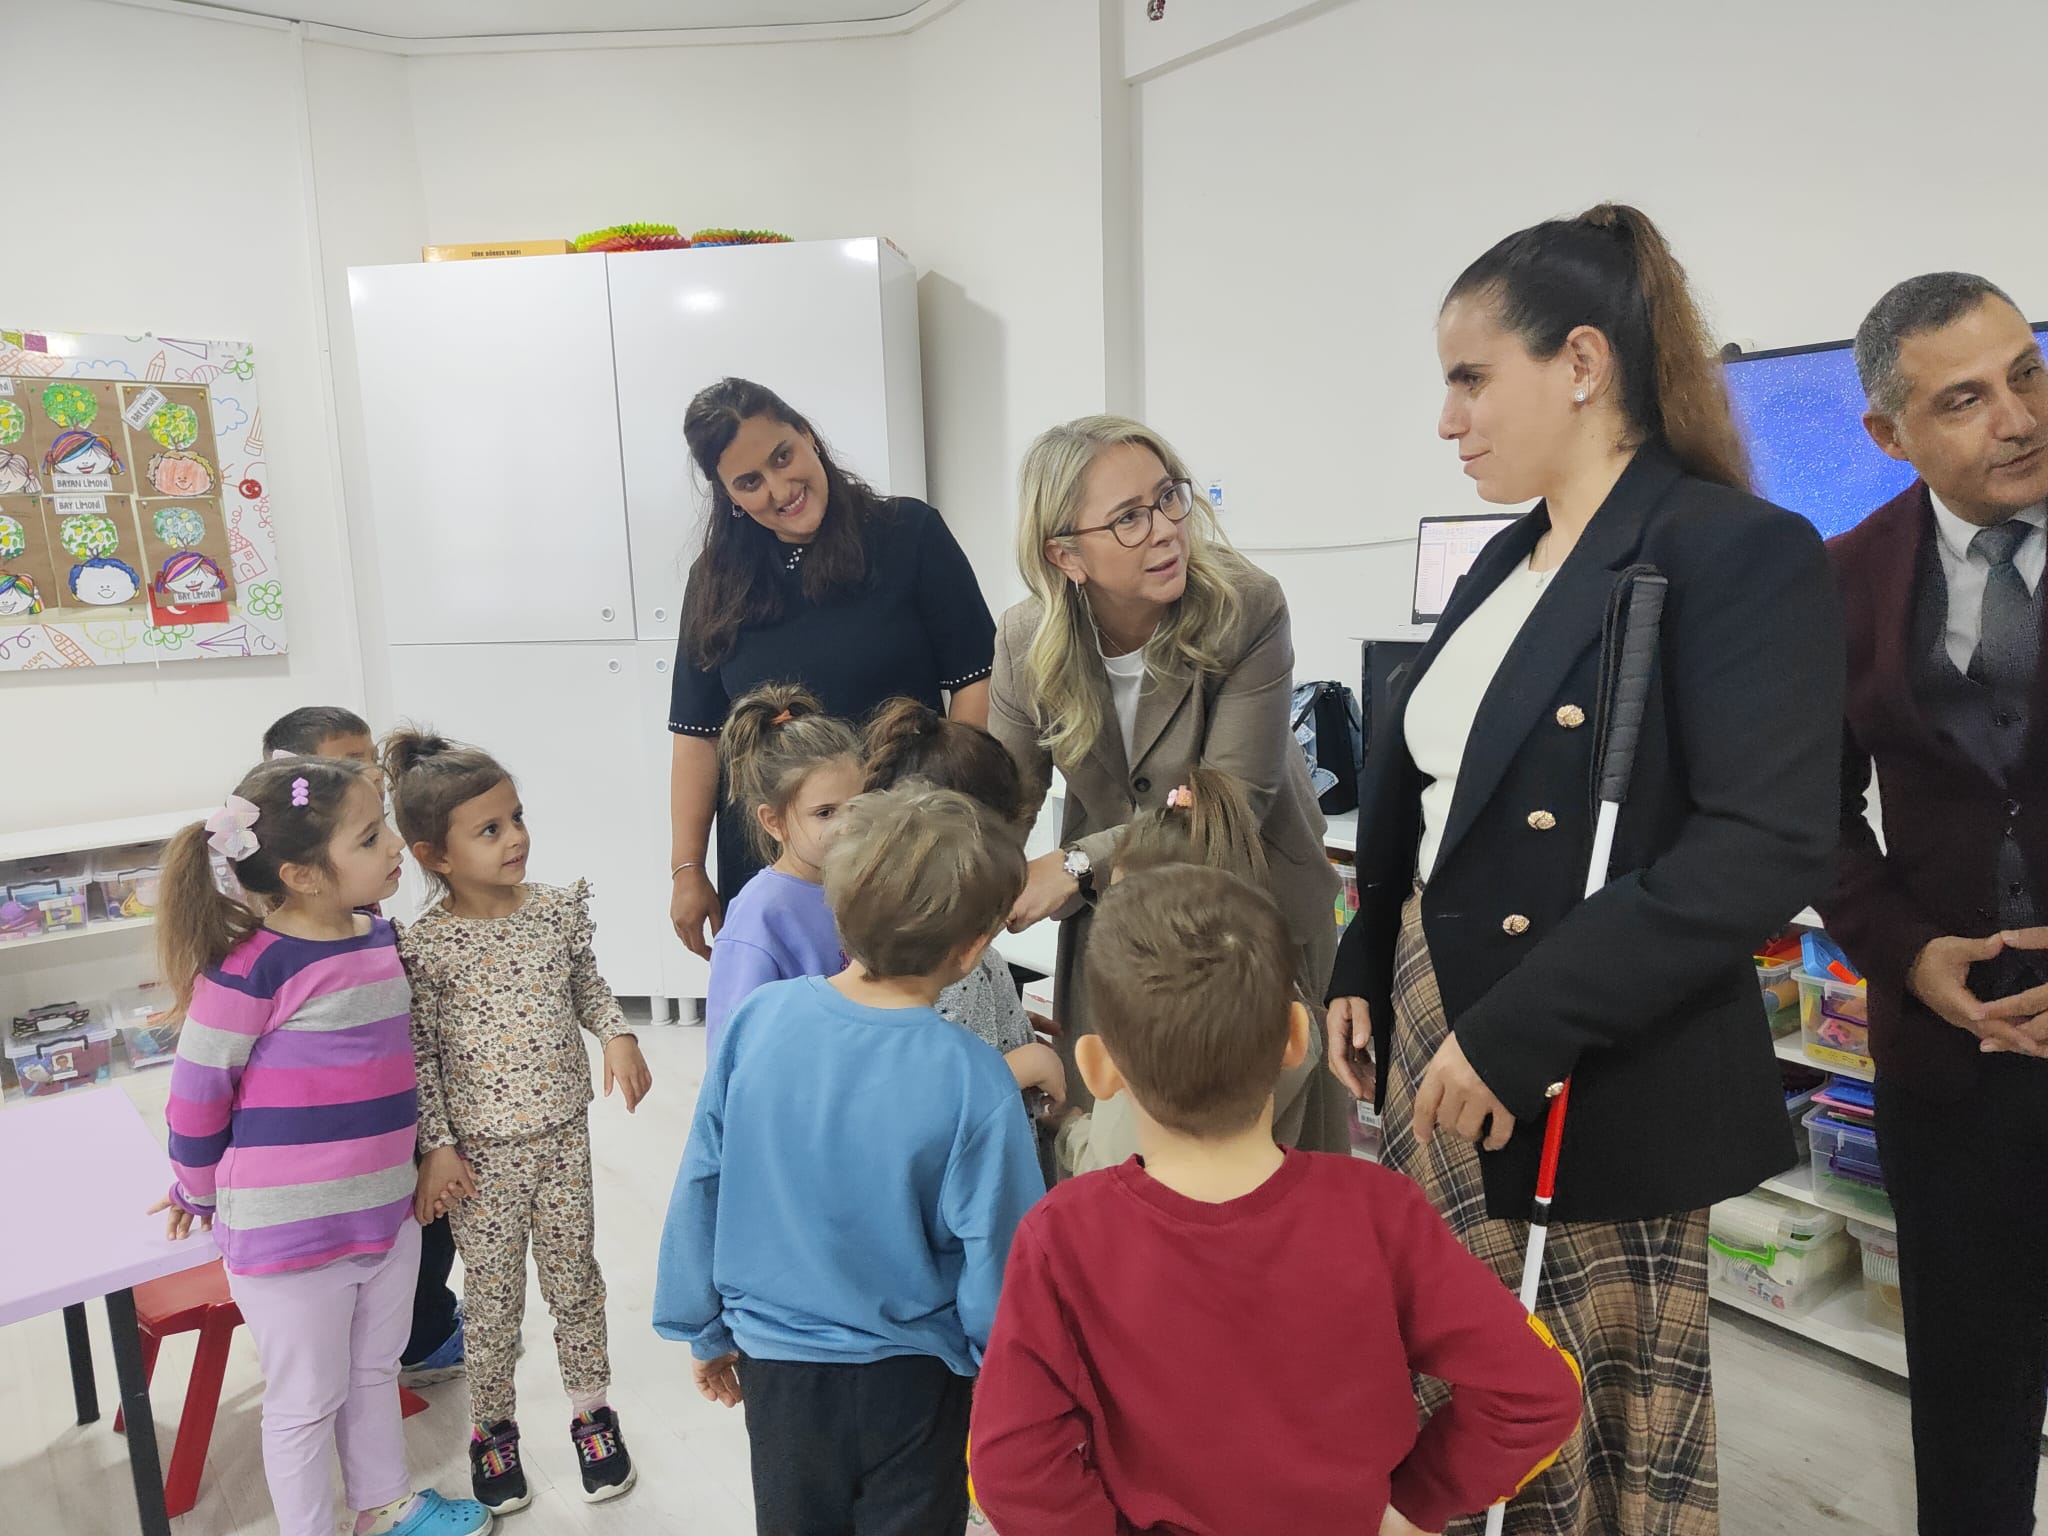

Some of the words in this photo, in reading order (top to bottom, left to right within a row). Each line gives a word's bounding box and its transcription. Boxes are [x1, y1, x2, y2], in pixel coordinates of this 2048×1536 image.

[130, 410, 144, 423] BAY
[57, 479, 81, 488] BAYAN
[59, 502, 73, 510] BAY
[178, 592, 190, 600] BAY
